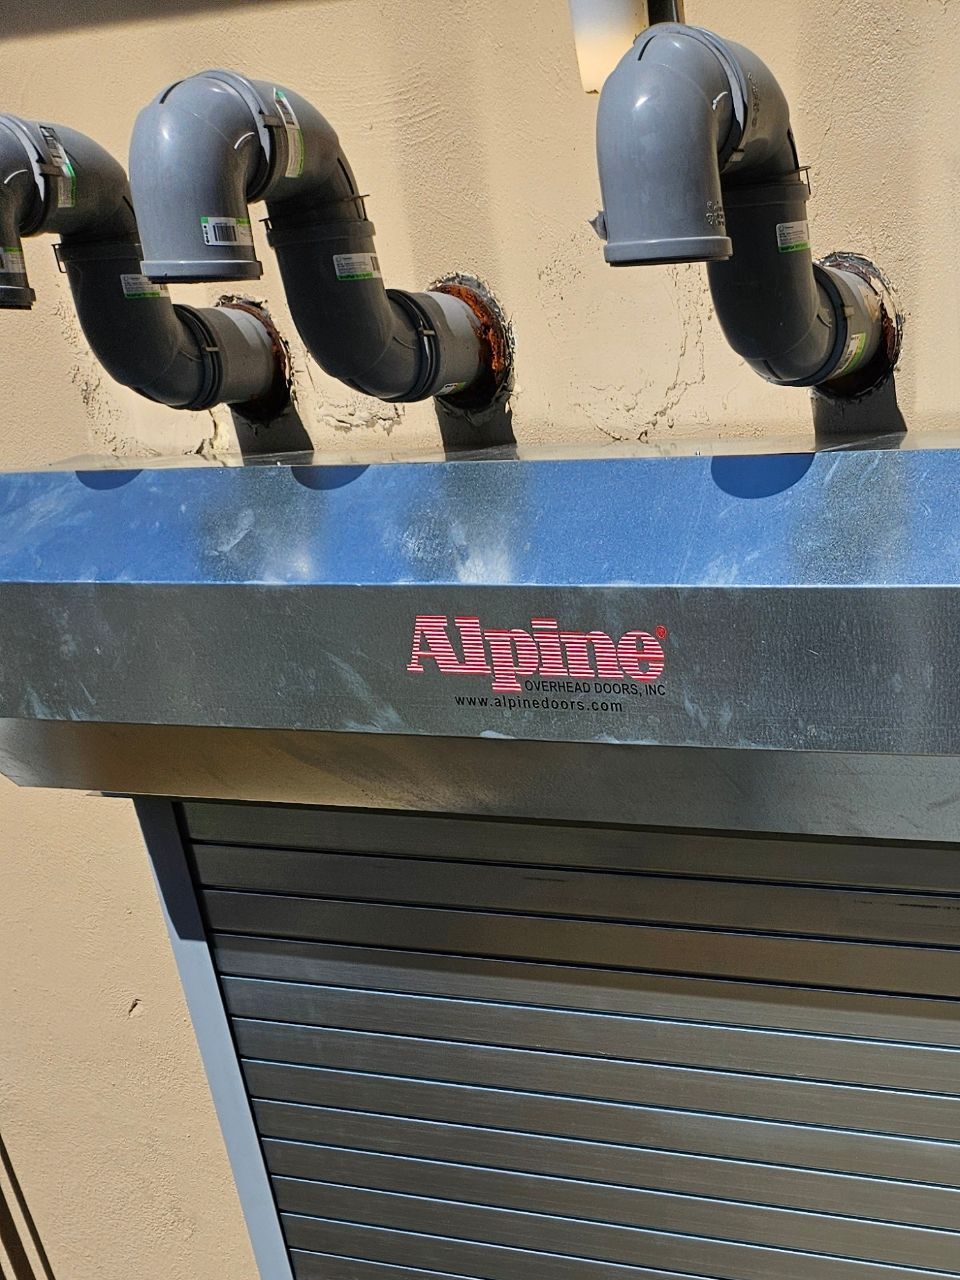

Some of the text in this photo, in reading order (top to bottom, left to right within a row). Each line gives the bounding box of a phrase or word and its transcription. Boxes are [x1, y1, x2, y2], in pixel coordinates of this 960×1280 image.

[406, 615, 665, 692] Alpine
[524, 680, 666, 698] OVERHEAD DOORS, INC
[455, 694, 623, 712] www.alpinedoors.com
